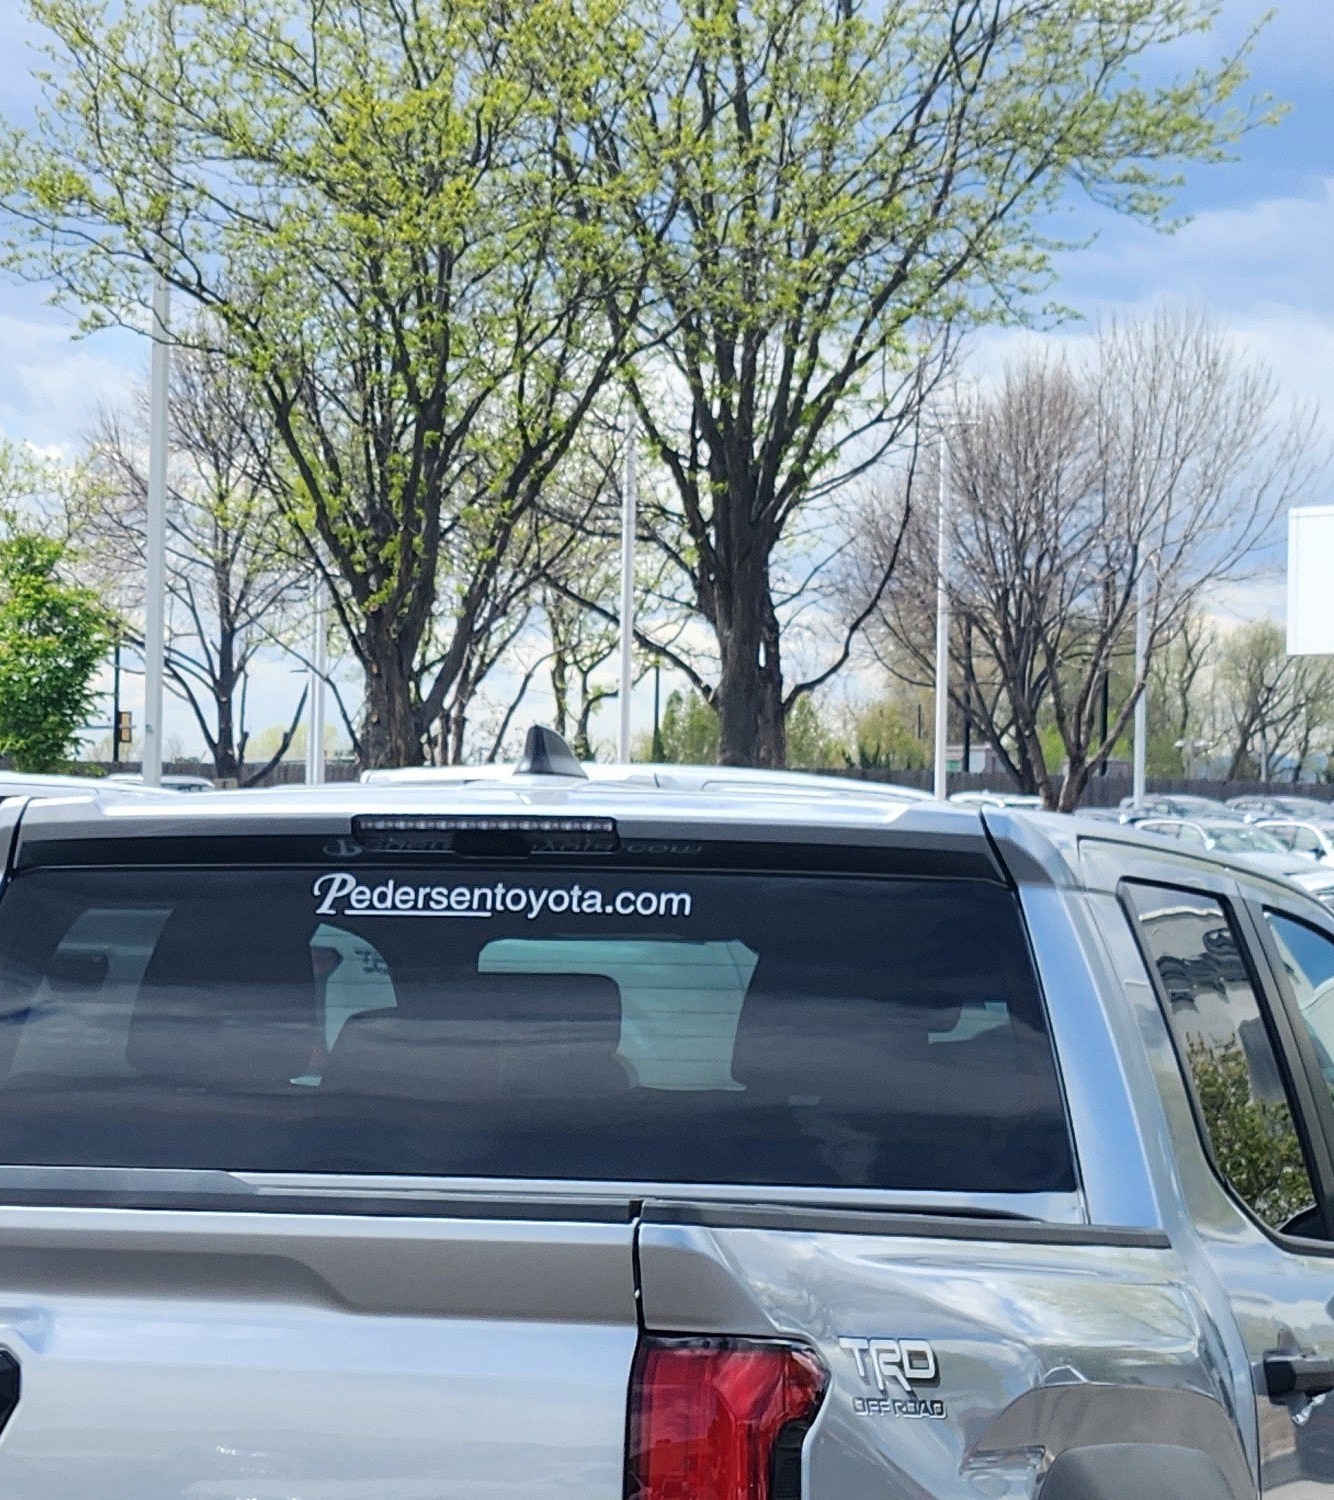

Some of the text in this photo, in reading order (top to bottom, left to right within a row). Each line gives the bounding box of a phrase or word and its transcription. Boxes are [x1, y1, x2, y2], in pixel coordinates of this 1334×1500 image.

[313, 872, 692, 919] Pedersentoyota.com
[838, 1336, 936, 1392] TRD
[853, 1398, 891, 1416] OFF
